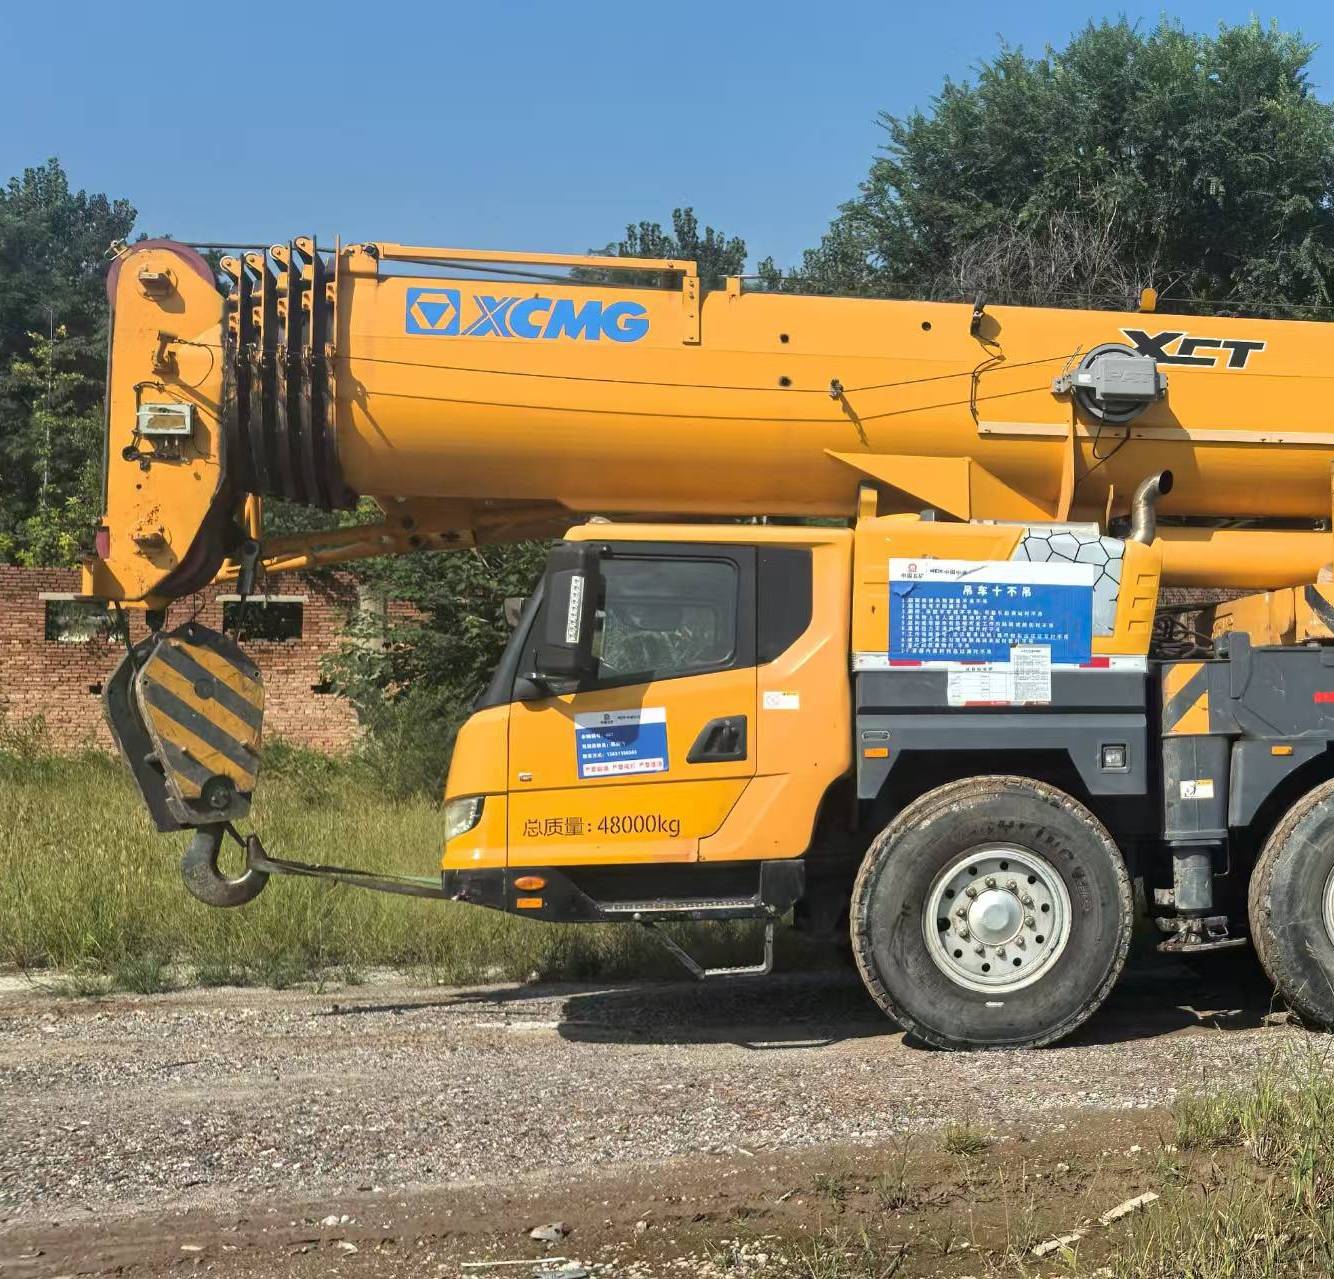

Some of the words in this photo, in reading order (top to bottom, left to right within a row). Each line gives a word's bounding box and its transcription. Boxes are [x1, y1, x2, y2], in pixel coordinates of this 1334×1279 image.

[461, 295, 647, 342] XCMG
[1120, 329, 1266, 368] XCT
[963, 585, 1032, 597] 吊车十不吊
